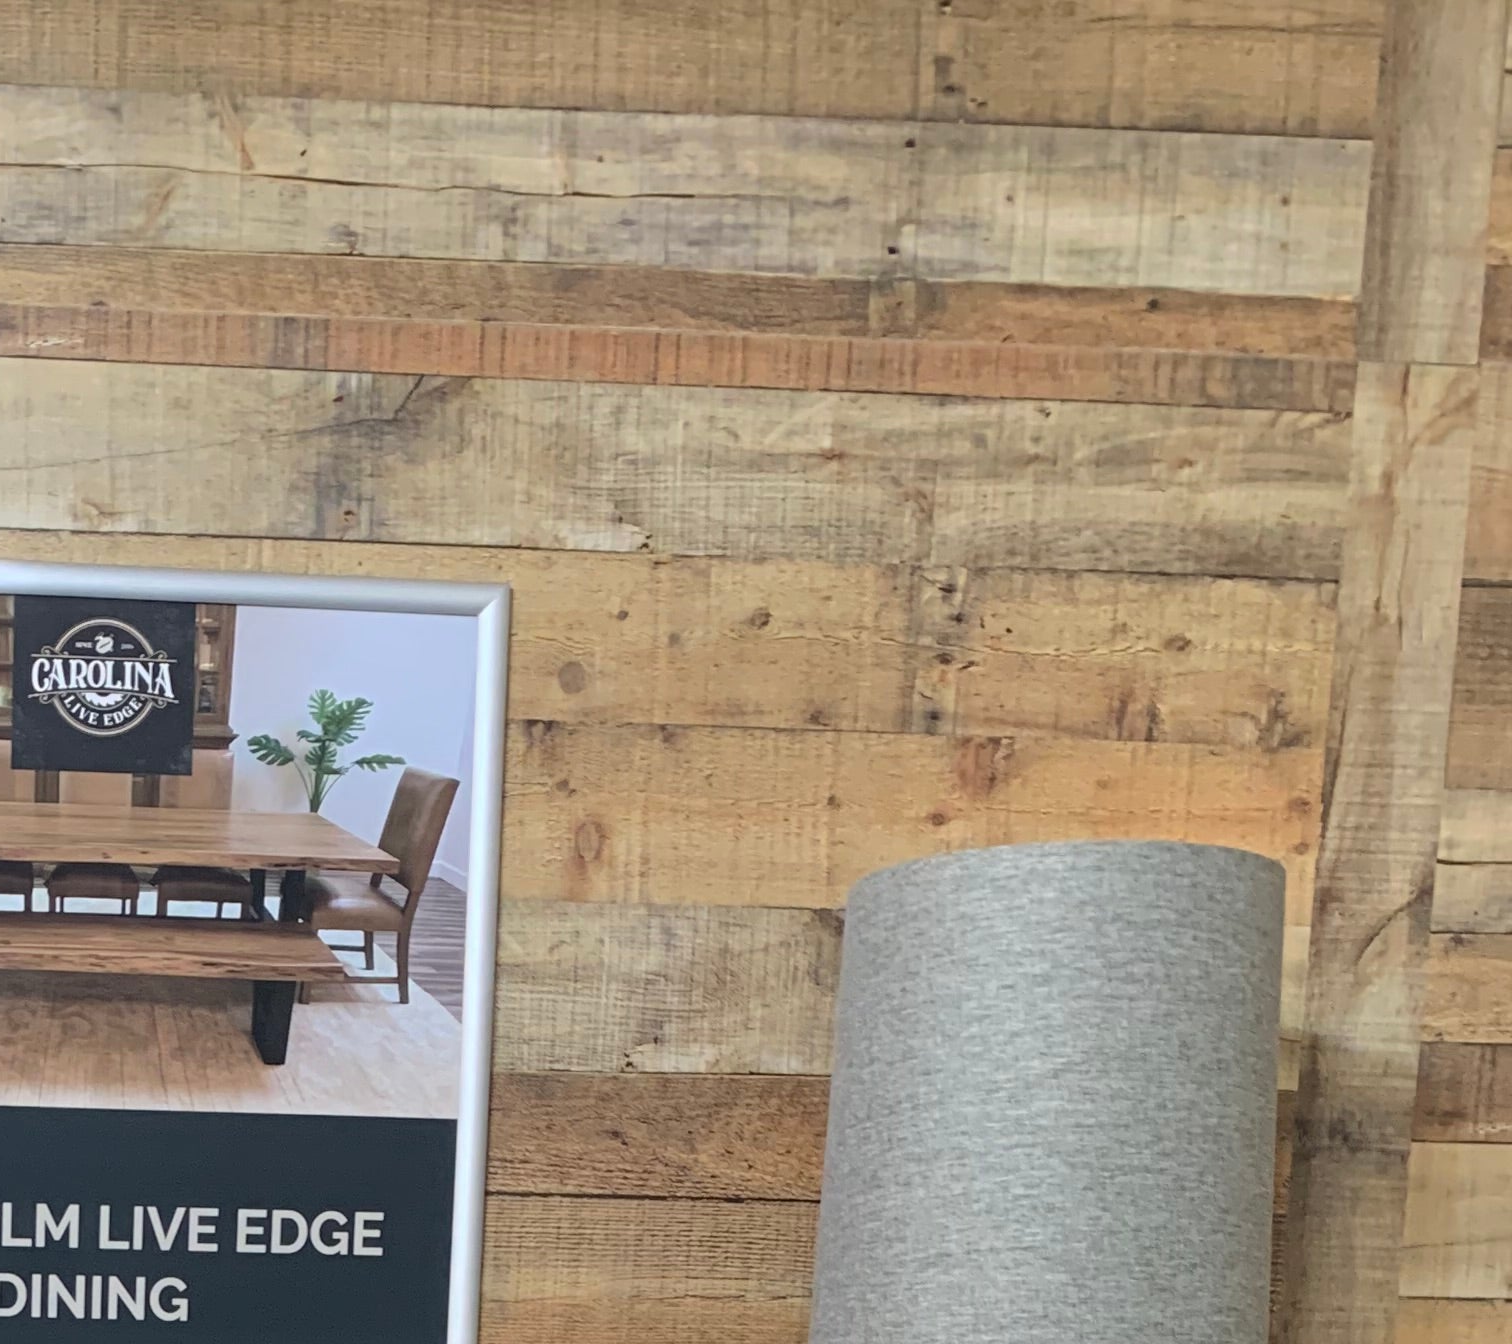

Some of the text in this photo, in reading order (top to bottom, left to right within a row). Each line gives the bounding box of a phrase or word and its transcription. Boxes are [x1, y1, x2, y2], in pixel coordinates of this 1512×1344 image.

[31, 658, 175, 698] CAROLINA
[63, 695, 142, 726] LIVE EDGE
[99, 1205, 219, 1252] LIVE
[236, 1209, 384, 1256] EDGE
